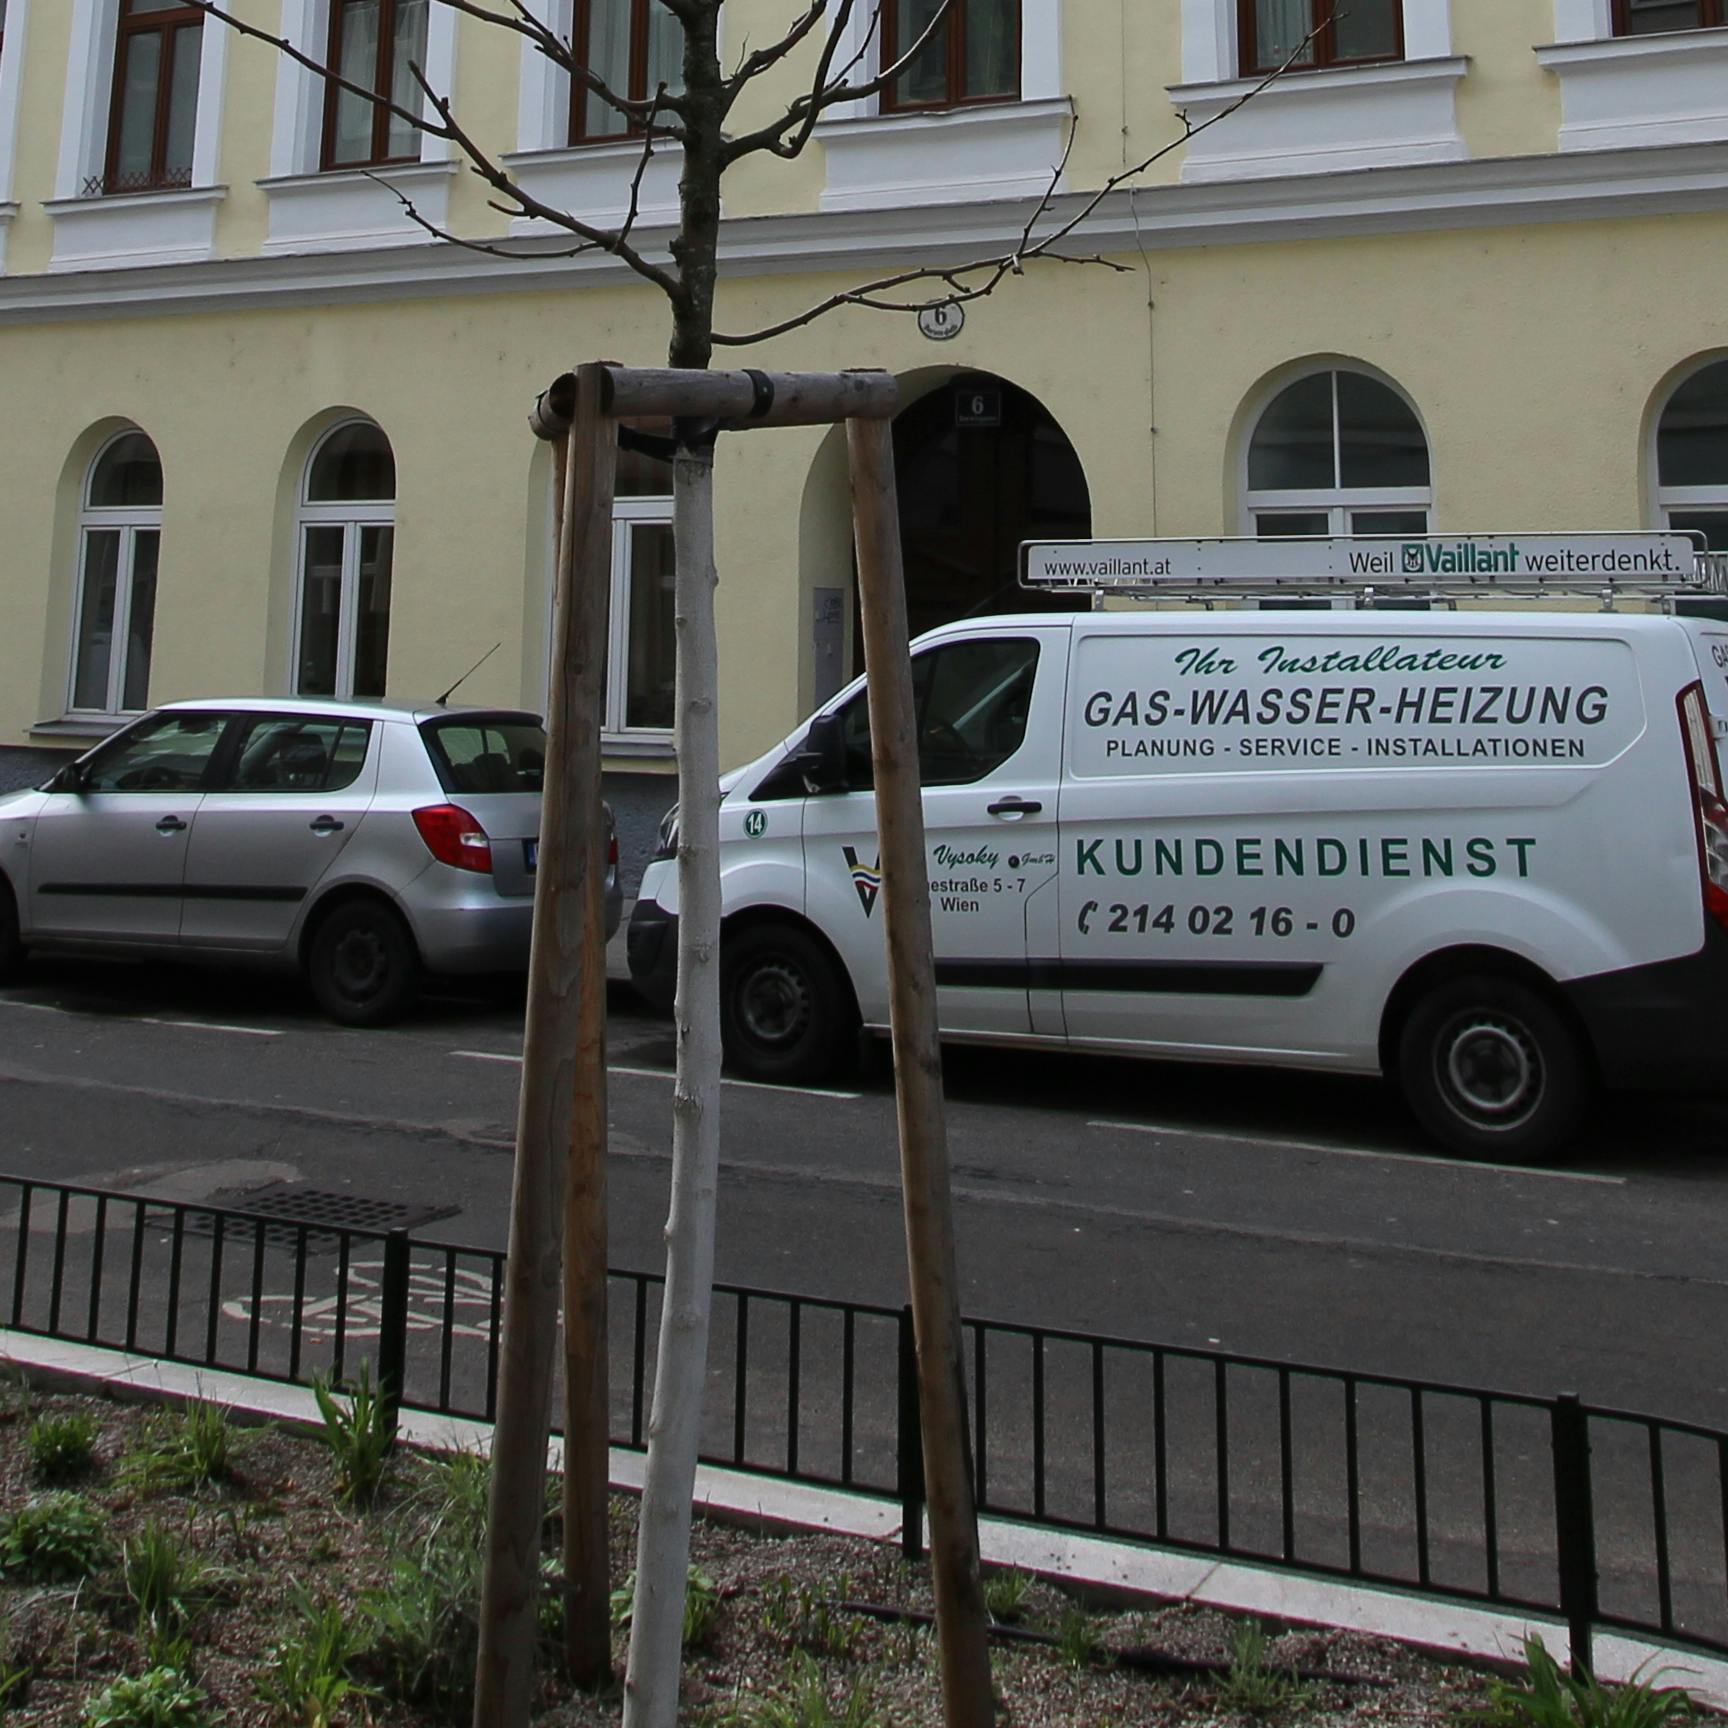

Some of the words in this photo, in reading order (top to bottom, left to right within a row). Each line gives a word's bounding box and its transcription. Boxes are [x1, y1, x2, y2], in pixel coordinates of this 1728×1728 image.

[935, 303, 947, 326] 6
[972, 395, 984, 414] 6
[1044, 558, 1171, 576] www.vaillant.at
[1349, 552, 1394, 573] Weil
[1425, 542, 1519, 573] Vaillant
[1525, 548, 1681, 573] weiterdenkt.
[1174, 646, 1238, 676] Ihr
[1257, 645, 1508, 674] Installateur
[1083, 685, 1609, 727] GAS-WASSER-HEIZUNG
[1106, 738, 1215, 757] PLANUNG
[1239, 738, 1341, 757] SERVICE
[1367, 738, 1585, 757] INSTALLATIONEN
[747, 813, 762, 834] 14
[932, 844, 1001, 870] Vysoky
[1076, 837, 1537, 878] KUNDENDIENST
[993, 878, 1002, 892] 5
[1016, 878, 1026, 892] 7
[940, 897, 979, 912] Wien
[1108, 903, 1175, 934] 214
[1188, 905, 1234, 936] 02
[1249, 906, 1294, 937] 16
[1331, 908, 1355, 939] 0
